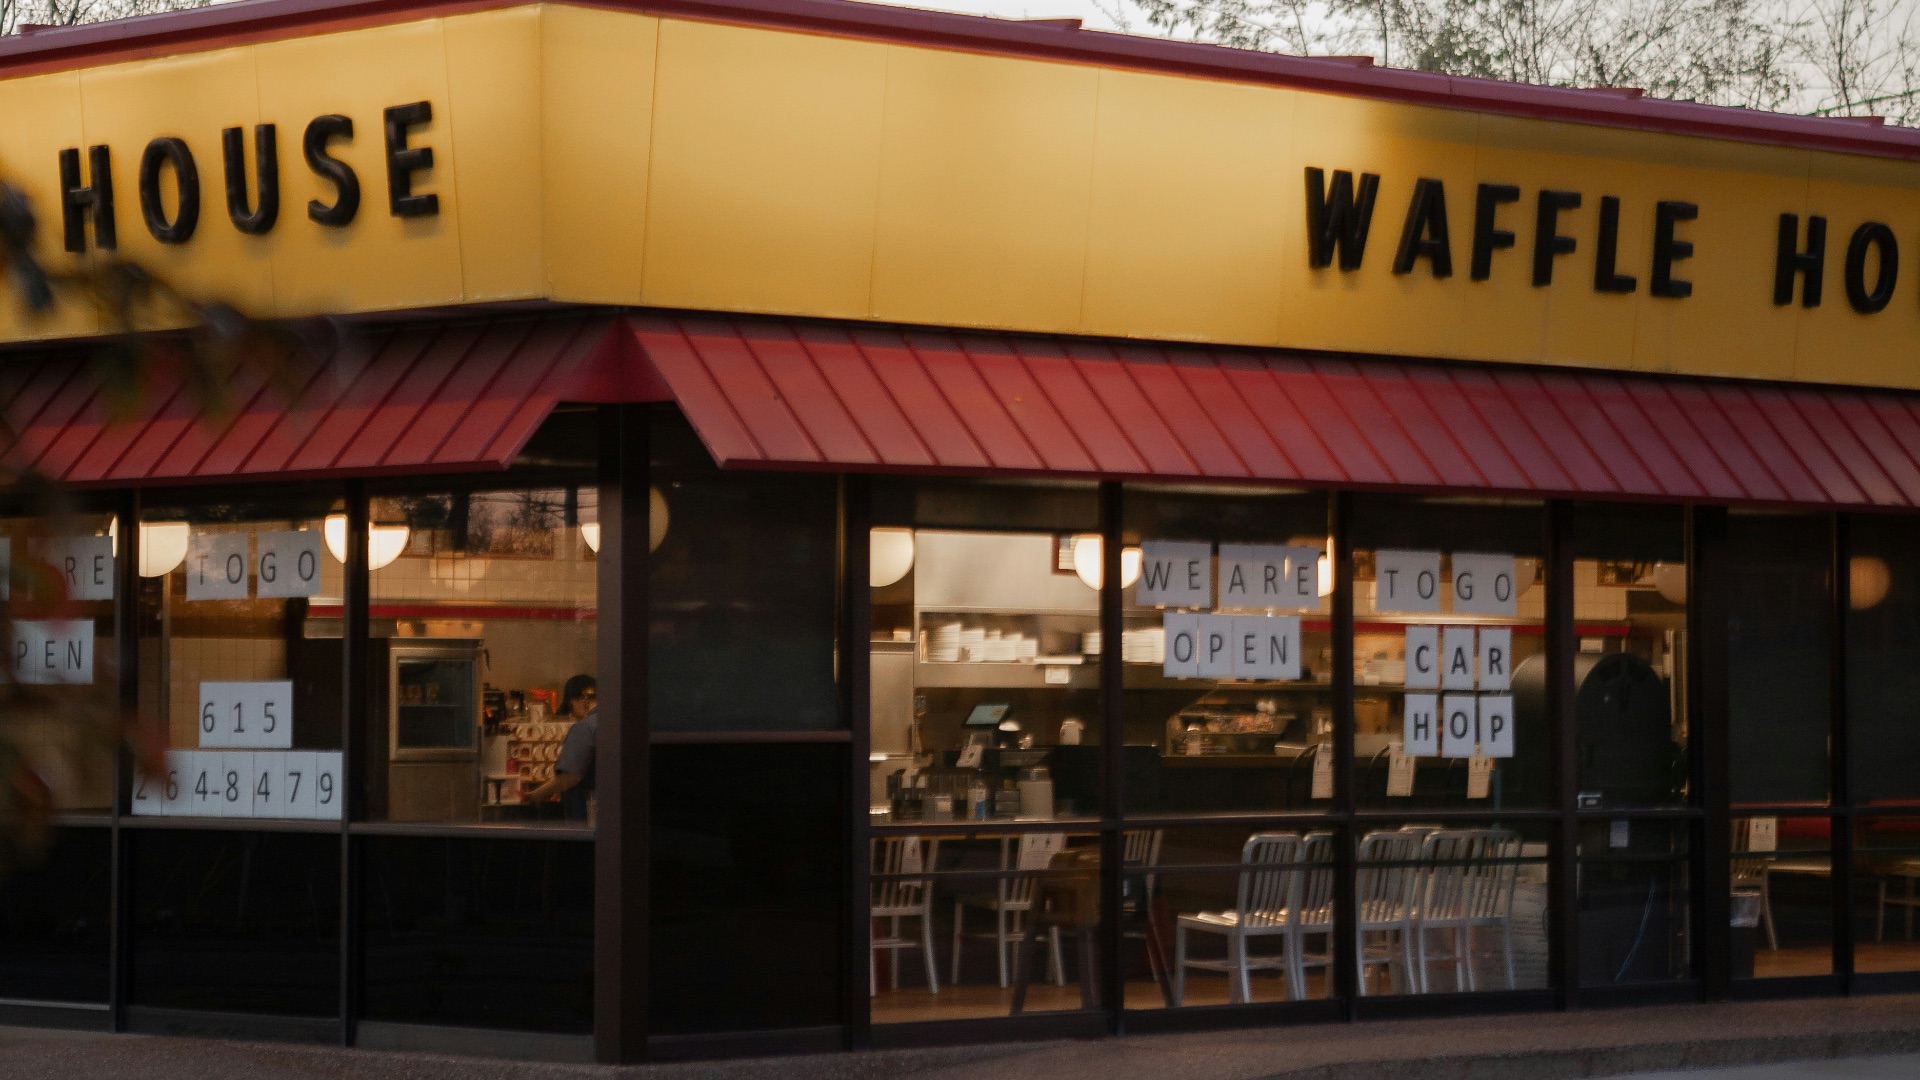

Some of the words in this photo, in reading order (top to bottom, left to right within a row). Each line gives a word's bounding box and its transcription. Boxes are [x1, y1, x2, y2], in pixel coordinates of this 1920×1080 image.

[59, 100, 439, 253] HOUSE
[1304, 166, 1698, 298] WAFFLE
[1773, 213, 1920, 315] HO
[63, 555, 105, 586] RE
[1142, 560, 1202, 591] WE
[1228, 564, 1310, 596] ARE
[1173, 631, 1289, 665] OPEN
[1414, 644, 1505, 677] CAR
[202, 702, 276, 734] 615
[1413, 710, 1505, 745] HOP
